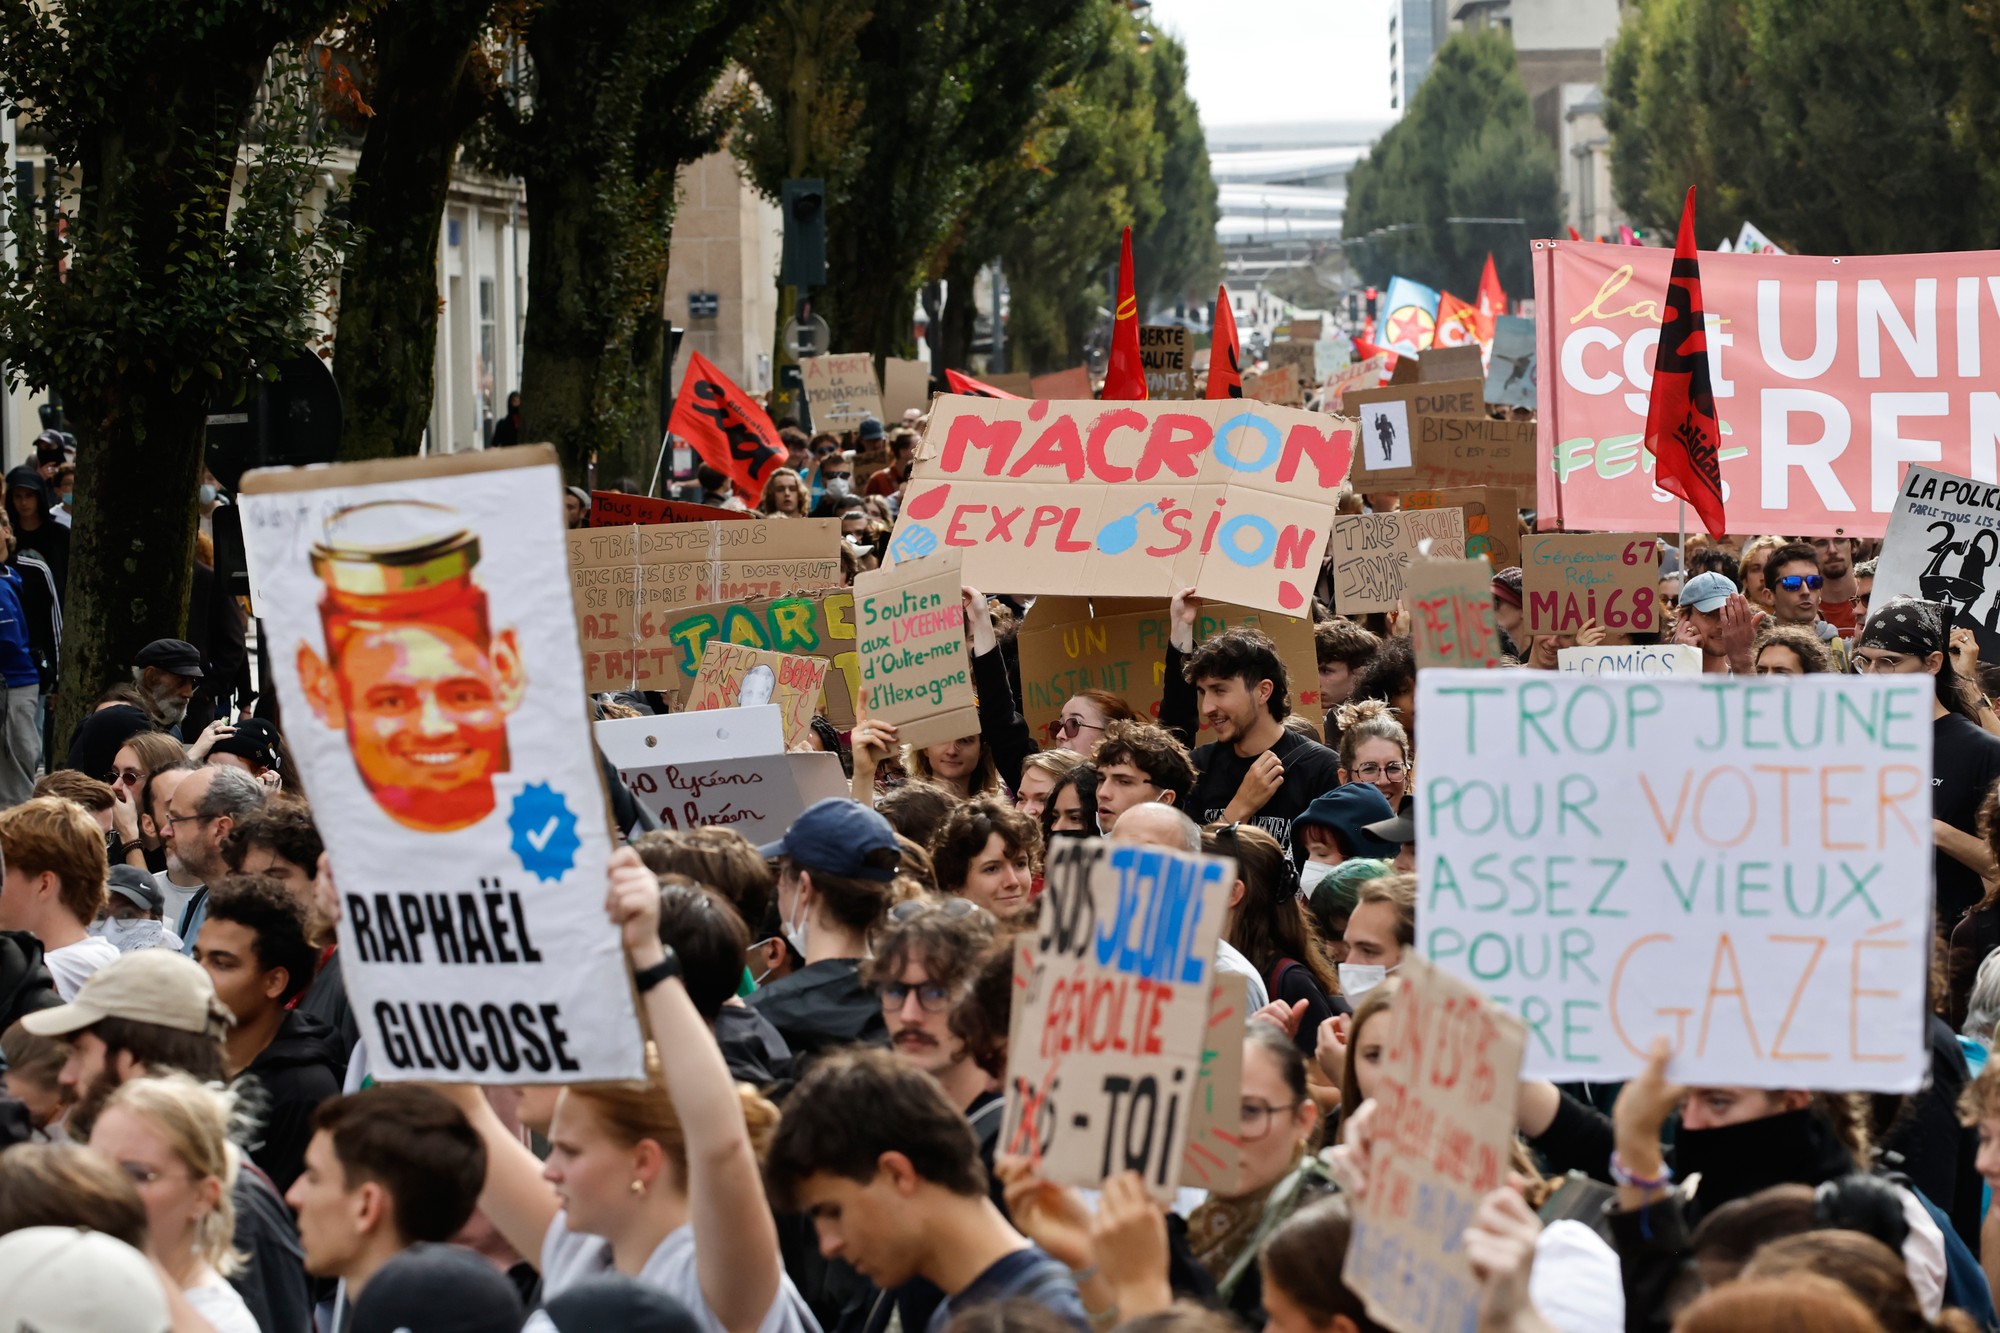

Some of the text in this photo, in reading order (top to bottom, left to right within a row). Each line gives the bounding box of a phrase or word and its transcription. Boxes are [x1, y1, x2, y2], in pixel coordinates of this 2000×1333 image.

[939, 407, 1352, 489] MACRON
[1906, 474, 1937, 500] LA
[590, 525, 767, 559] TRADITIONS
[1622, 541, 1656, 566] 67
[574, 563, 692, 588] ANCAISES
[742, 561, 838, 580] DOIVENT
[615, 585, 687, 608] PERDRE
[863, 590, 941, 625] Soutien
[1603, 587, 1654, 630] 68
[861, 636, 890, 654] aux
[1437, 682, 1920, 756] TROP JEUNE
[1427, 764, 1926, 851] POUR VOTER
[1427, 852, 1630, 917] ASSEZ
[346, 877, 541, 965] RAPHAËL
[373, 1001, 582, 1073] GLUCOSE
